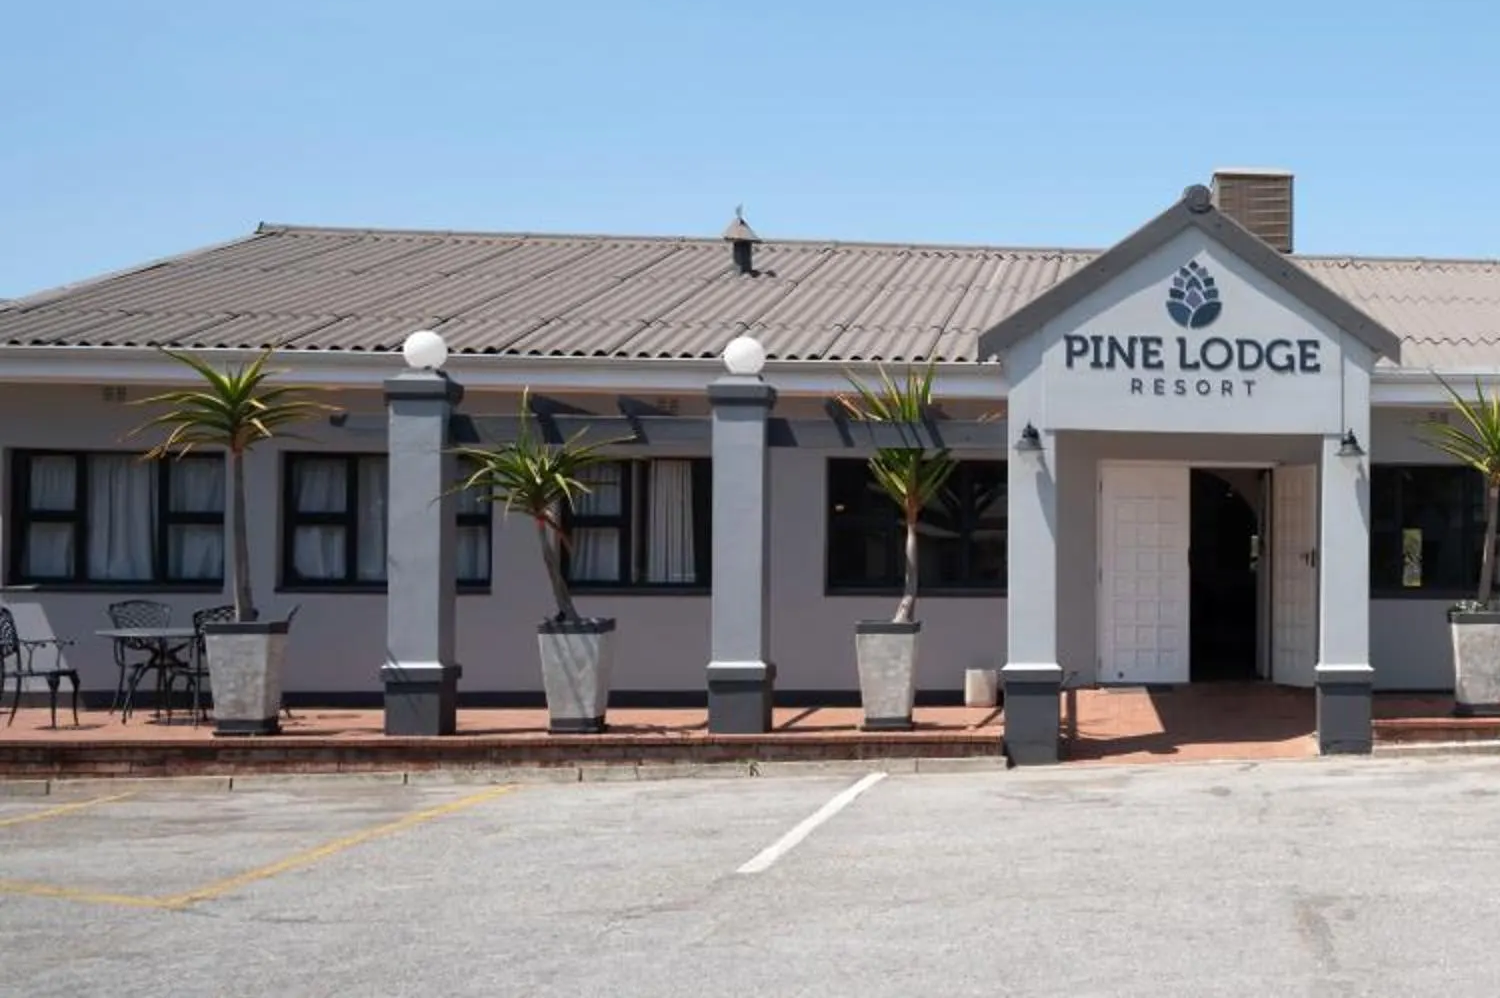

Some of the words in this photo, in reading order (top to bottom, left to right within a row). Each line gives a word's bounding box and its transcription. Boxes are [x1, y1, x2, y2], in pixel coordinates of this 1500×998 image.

[1063, 335, 1164, 369] PINE
[1177, 336, 1321, 372] LODGE
[1130, 378, 1256, 396] RESORT
